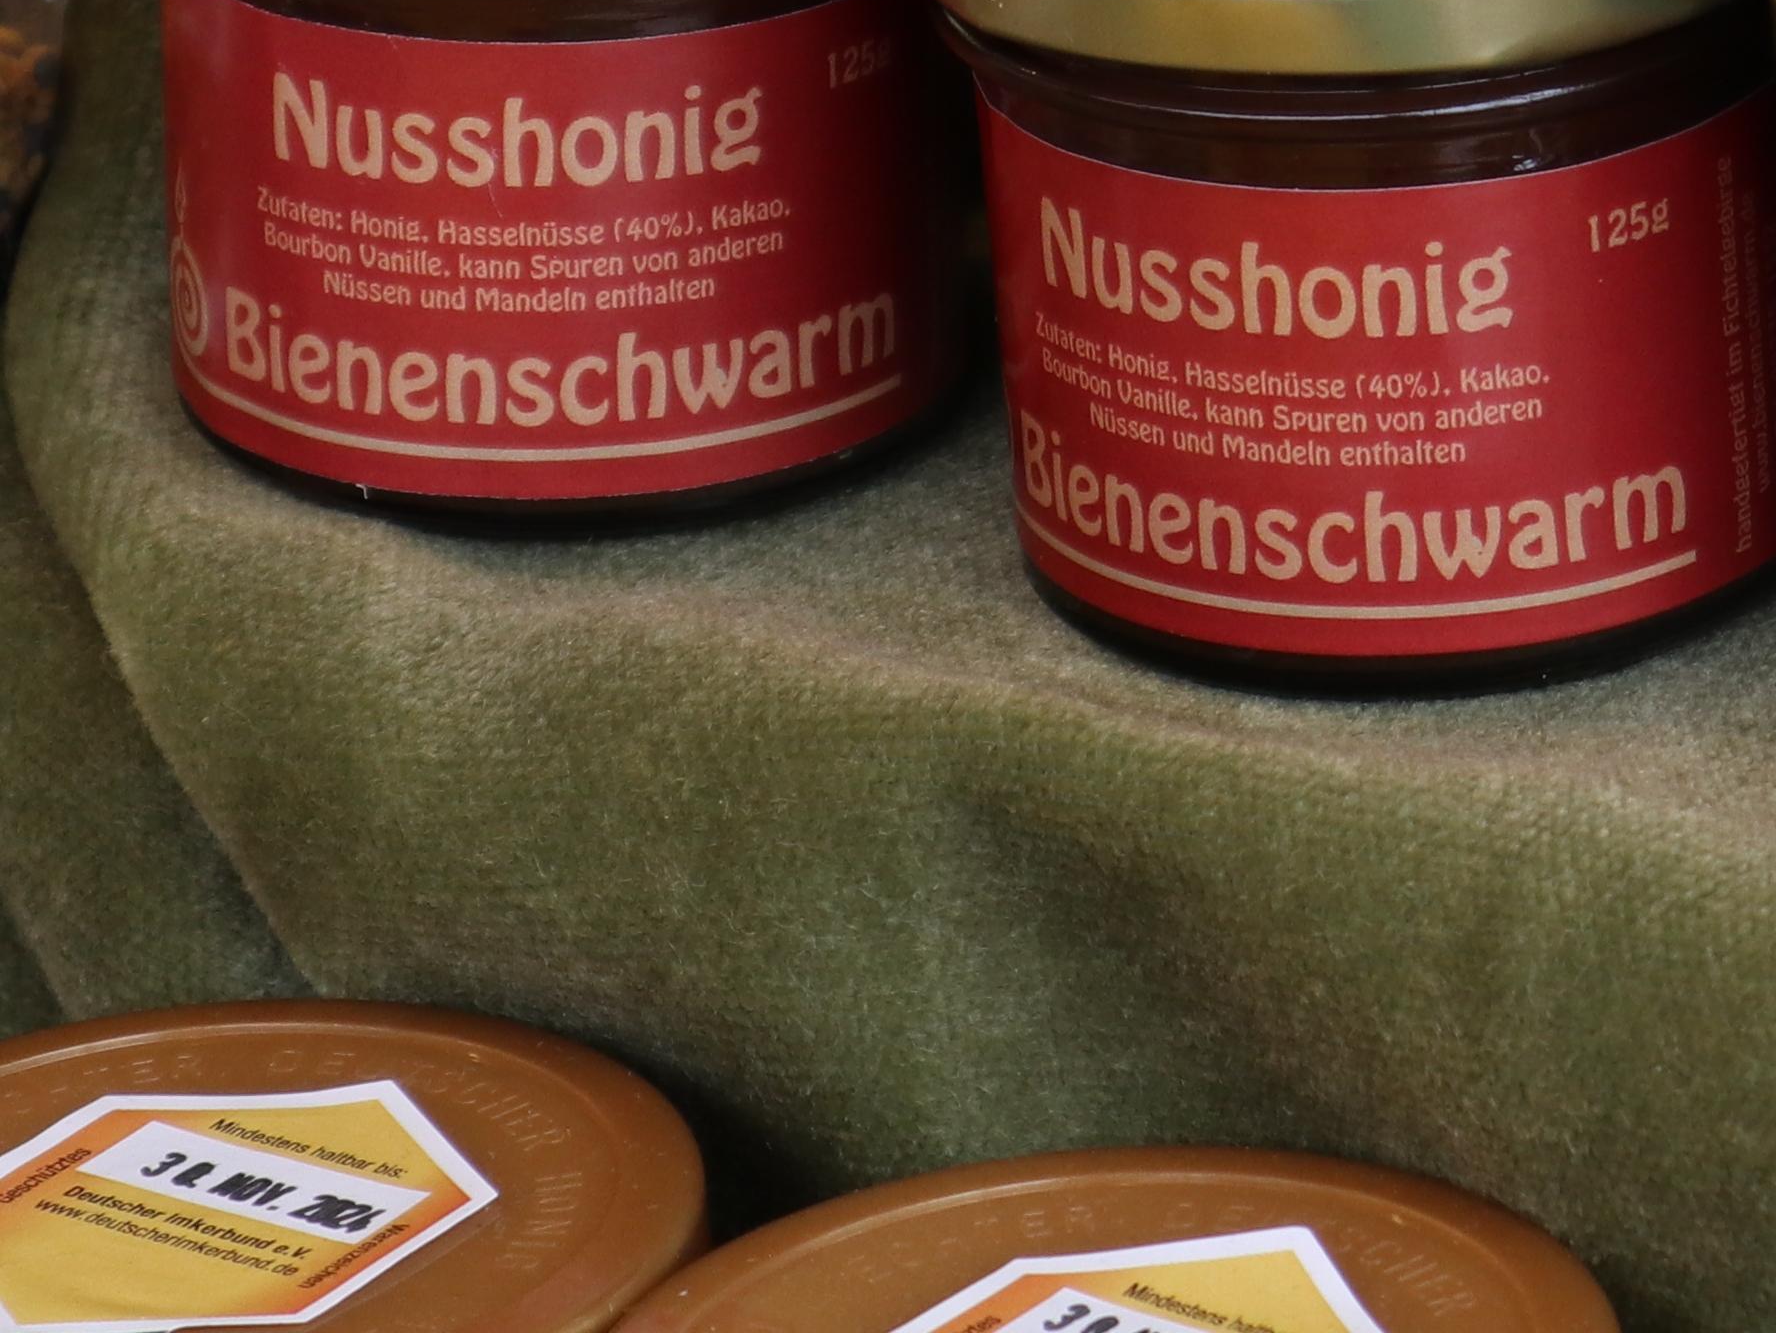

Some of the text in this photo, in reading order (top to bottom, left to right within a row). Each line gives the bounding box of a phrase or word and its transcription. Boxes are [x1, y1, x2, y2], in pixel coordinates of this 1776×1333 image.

[272, 69, 764, 190] Nusshonig
[257, 185, 343, 231] Zutaten:
[438, 218, 604, 247] Hasselnüsse
[264, 221, 351, 266] Bourbon
[459, 254, 521, 280] kann
[530, 253, 623, 280] Spuren
[632, 251, 678, 274] von
[688, 231, 784, 268] anderen
[323, 270, 715, 313] Nüssen und Mandeln enthalten
[1040, 195, 1671, 339] Nusshonig 125g
[224, 284, 897, 429] Bienenschwarm
[1020, 416, 1688, 583] Bienenschwarm
[209, 1117, 372, 1173] Mindestens haltbar
[33, 1197, 300, 1277] www.deutscherimkerbund.de
[62, 1183, 317, 1261] Deutscher Imkerbund e.V.
[211, 1170, 385, 1233] NOV. 2024
